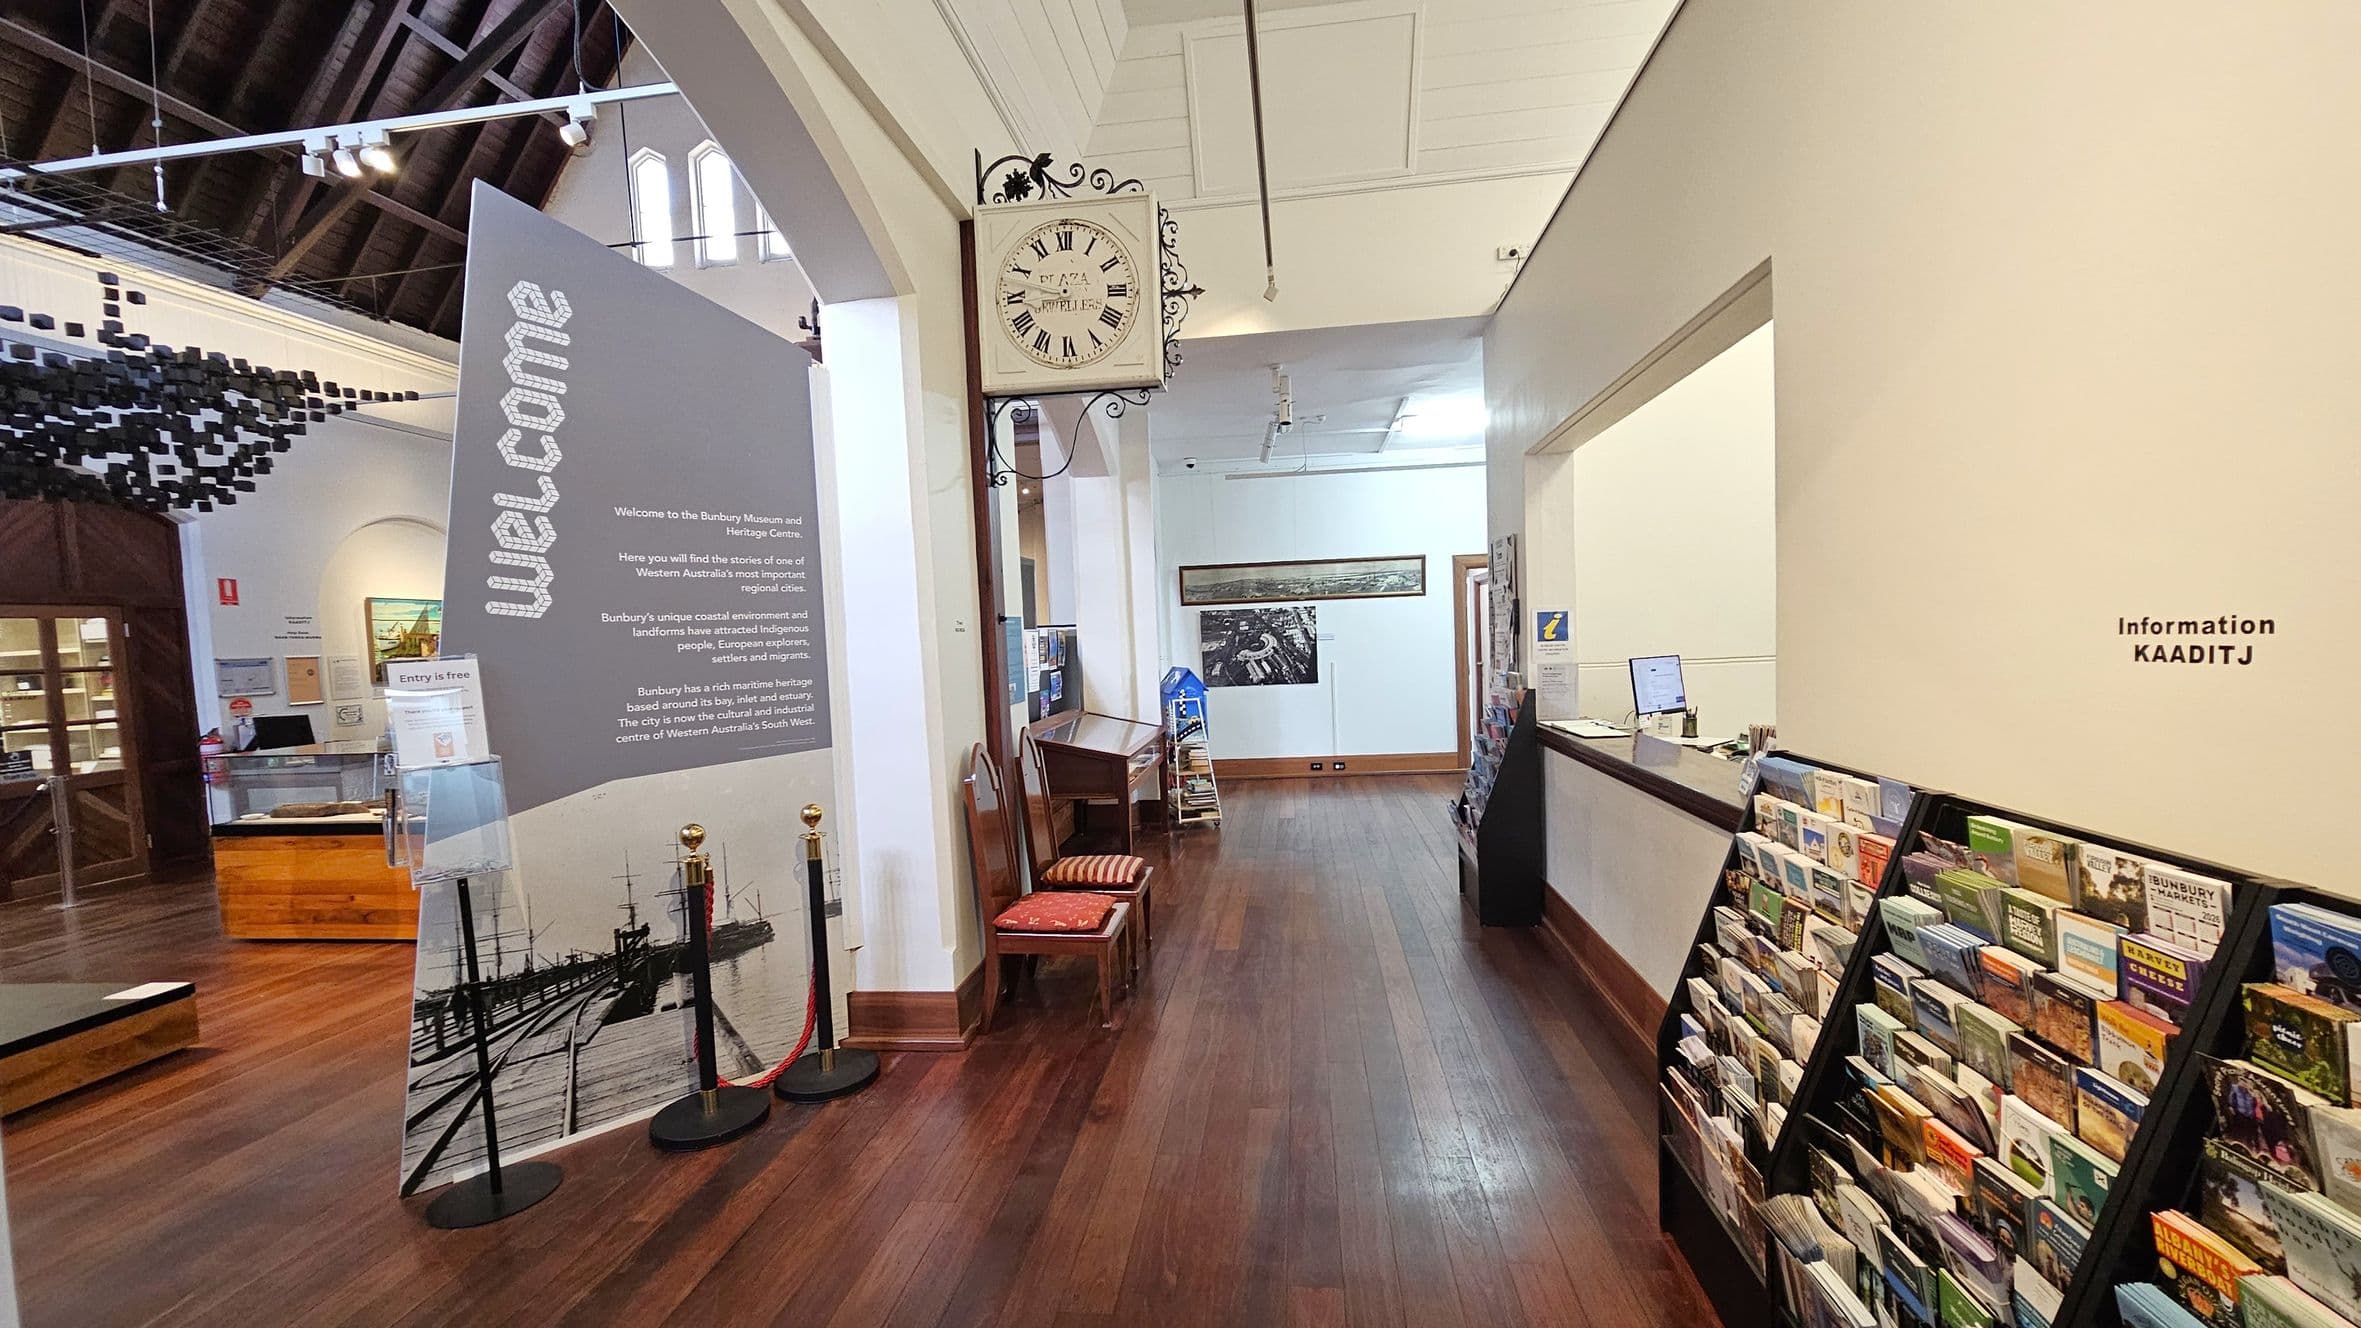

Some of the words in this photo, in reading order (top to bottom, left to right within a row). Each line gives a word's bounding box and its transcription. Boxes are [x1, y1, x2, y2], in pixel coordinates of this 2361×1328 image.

[1031, 238, 1050, 262] XI
[1056, 231, 1072, 251] XII
[1085, 237, 1097, 256] I
[1012, 263, 1032, 279] X
[1100, 256, 1120, 273] II
[1107, 284, 1127, 297] III
[615, 507, 664, 518] Welcome
[667, 510, 678, 519] to
[682, 511, 697, 520] the
[701, 512, 741, 524] Bunbury
[744, 514, 782, 524] Museum
[786, 516, 801, 525] and
[727, 527, 767, 538] Heritage
[770, 529, 803, 538] Centre.
[619, 553, 645, 562] Here
[648, 554, 667, 564] you
[670, 554, 687, 563] will
[690, 554, 708, 563] find
[712, 555, 728, 564] the
[730, 556, 761, 564] stories
[765, 556, 773, 564] of
[795, 556, 804, 565] of
[636, 568, 680, 577] Western
[736, 570, 759, 578] most
[762, 570, 805, 580] important
[742, 584, 778, 594] regional
[781, 584, 806, 592] cities.
[658, 613, 692, 623] unique
[695, 612, 729, 620] coastal
[732, 611, 789, 620] environment
[792, 611, 808, 619] and
[2119, 615, 2276, 635] Information
[633, 627, 685, 637] landforms
[688, 627, 711, 635] have
[714, 625, 757, 634] attracted
[760, 624, 809, 634] Indigenous
[678, 641, 715, 652] people,
[718, 640, 763, 650] European
[766, 638, 809, 648] explorers,
[712, 654, 747, 663] settlers
[750, 653, 767, 662] and
[770, 652, 810, 662] migrants.
[2134, 645, 2253, 665] KAADITJ
[400, 674, 432, 683] Entry
[435, 672, 444, 680] is
[638, 687, 681, 698] Bunbury
[684, 685, 701, 693] has
[712, 683, 730, 691] rich
[733, 681, 773, 690] maritime
[776, 678, 812, 689] heritage
[627, 702, 659, 712] based
[662, 699, 697, 709] around
[700, 698, 712, 707] its
[715, 697, 734, 707] bay,
[737, 695, 757, 704] inlet
[760, 693, 777, 702] and
[780, 692, 813, 702] estuary.
[618, 718, 638, 728] The
[642, 716, 660, 727] city
[663, 715, 671, 724] is
[698, 712, 714, 721] the
[717, 709, 752, 719] cultural
[755, 707, 771, 716] and
[774, 704, 814, 714] industrial
[616, 732, 649, 743] centre
[653, 730, 664, 740] of
[667, 727, 708, 738] Western
[762, 720, 788, 729] South
[791, 717, 815, 727] West.
[2153, 875, 2215, 900] BUNBURY
[2158, 888, 2208, 908] MARKETS
[2127, 946, 2180, 972] HARVEY
[2129, 963, 2184, 991] CHEESE
[2154, 1223, 2231, 1281] ALBANY'S
[2156, 1239, 2233, 1298] RIVERBOAT
